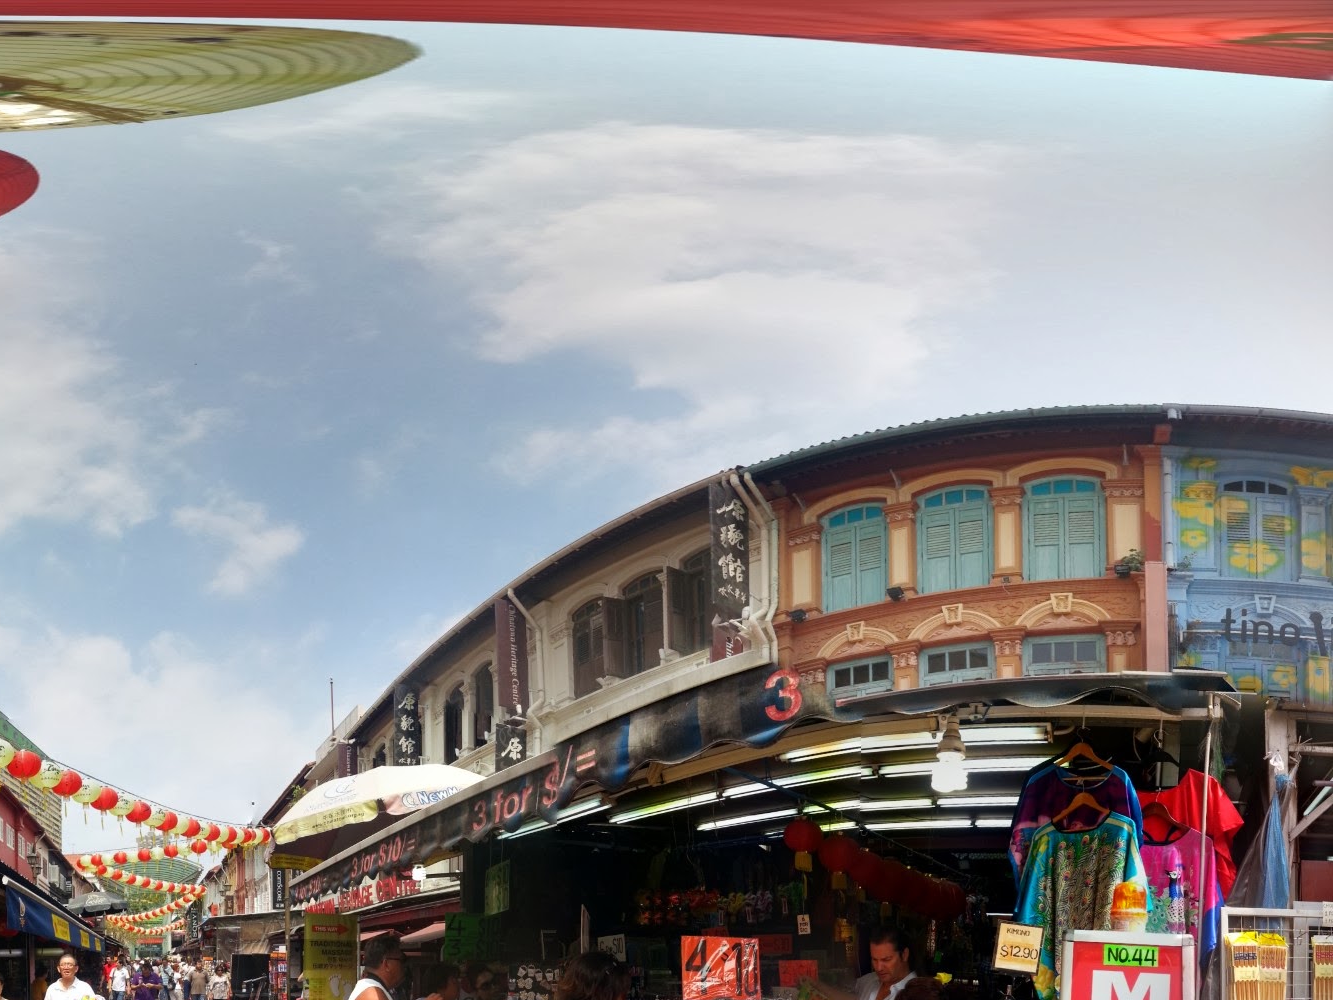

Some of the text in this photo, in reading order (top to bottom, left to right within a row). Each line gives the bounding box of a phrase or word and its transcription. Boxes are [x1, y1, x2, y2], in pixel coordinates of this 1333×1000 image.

[765, 669, 803, 722] 3
[472, 798, 487, 832] 3
[494, 783, 534, 826] for
[351, 859, 358, 877] 3
[358, 853, 374, 872] for
[1006, 927, 1030, 937] KIMONO
[1000, 945, 1039, 960] $12.90
[1107, 947, 1157, 967] NO.44
[685, 940, 711, 995] 4
